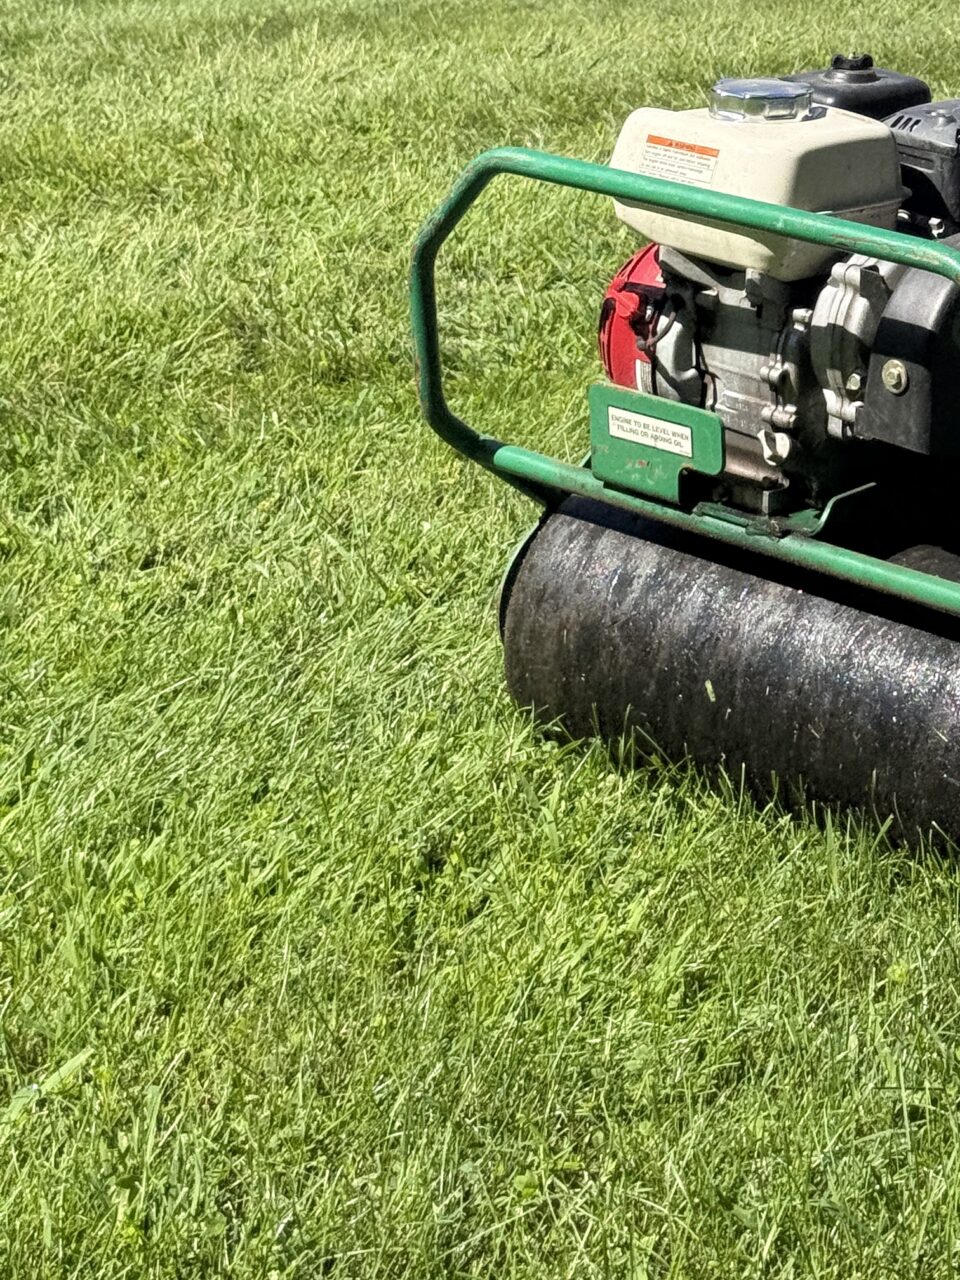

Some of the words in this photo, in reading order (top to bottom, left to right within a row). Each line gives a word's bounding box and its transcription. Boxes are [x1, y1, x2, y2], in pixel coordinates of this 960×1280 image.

[611, 414, 632, 426] ENGINE
[633, 420, 642, 428] TO
[643, 423, 651, 431] BE
[652, 425, 670, 436] LEVEL
[671, 431, 689, 441] WHEN
[617, 424, 639, 436] FILLING
[640, 430, 649, 438] OR
[650, 433, 672, 445] ADDING
